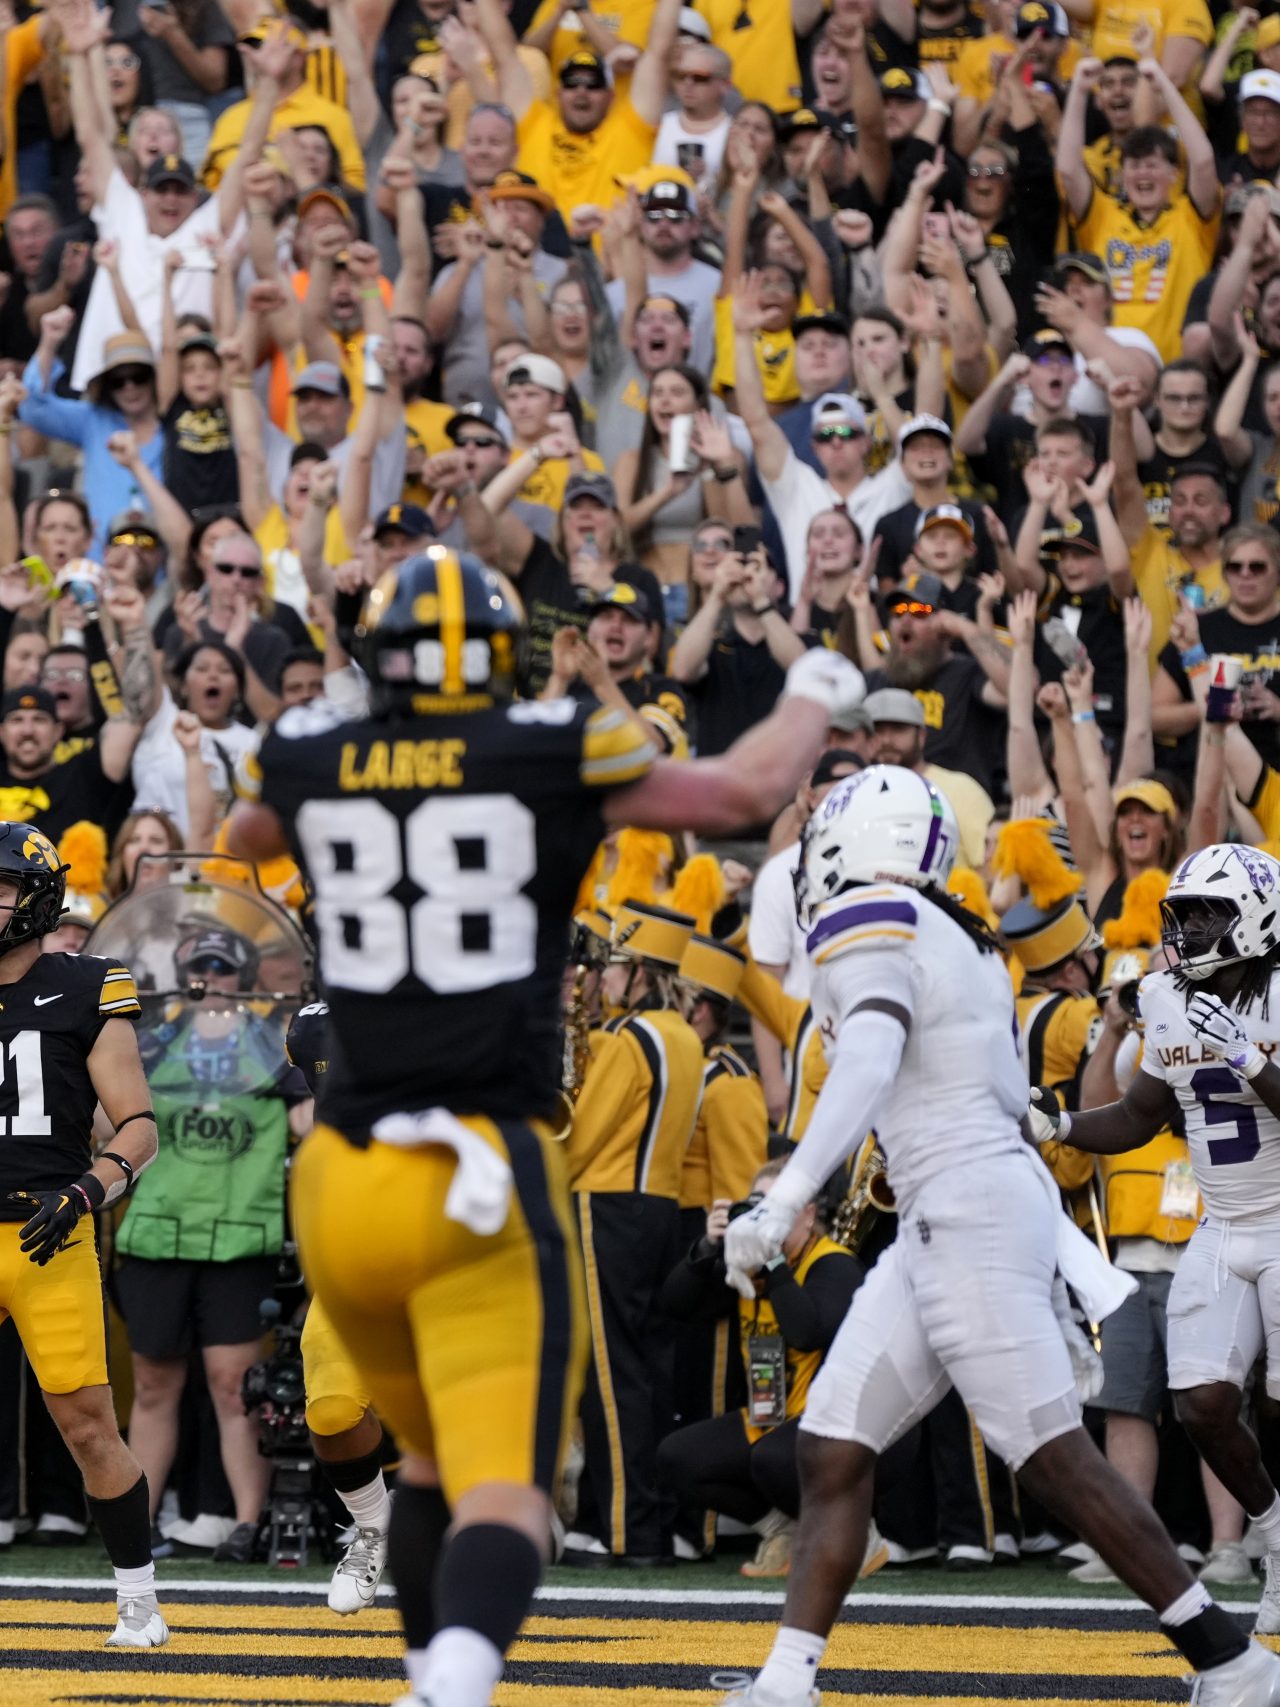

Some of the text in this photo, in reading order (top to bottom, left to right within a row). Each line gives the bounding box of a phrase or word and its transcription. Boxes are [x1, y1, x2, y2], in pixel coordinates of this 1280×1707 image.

[338, 739, 466, 791] LARGE
[296, 793, 537, 995] 88
[1157, 1040, 1278, 1068] UALBY
[181, 1114, 235, 1140] FOX
[1190, 1068, 1262, 1166] 5
